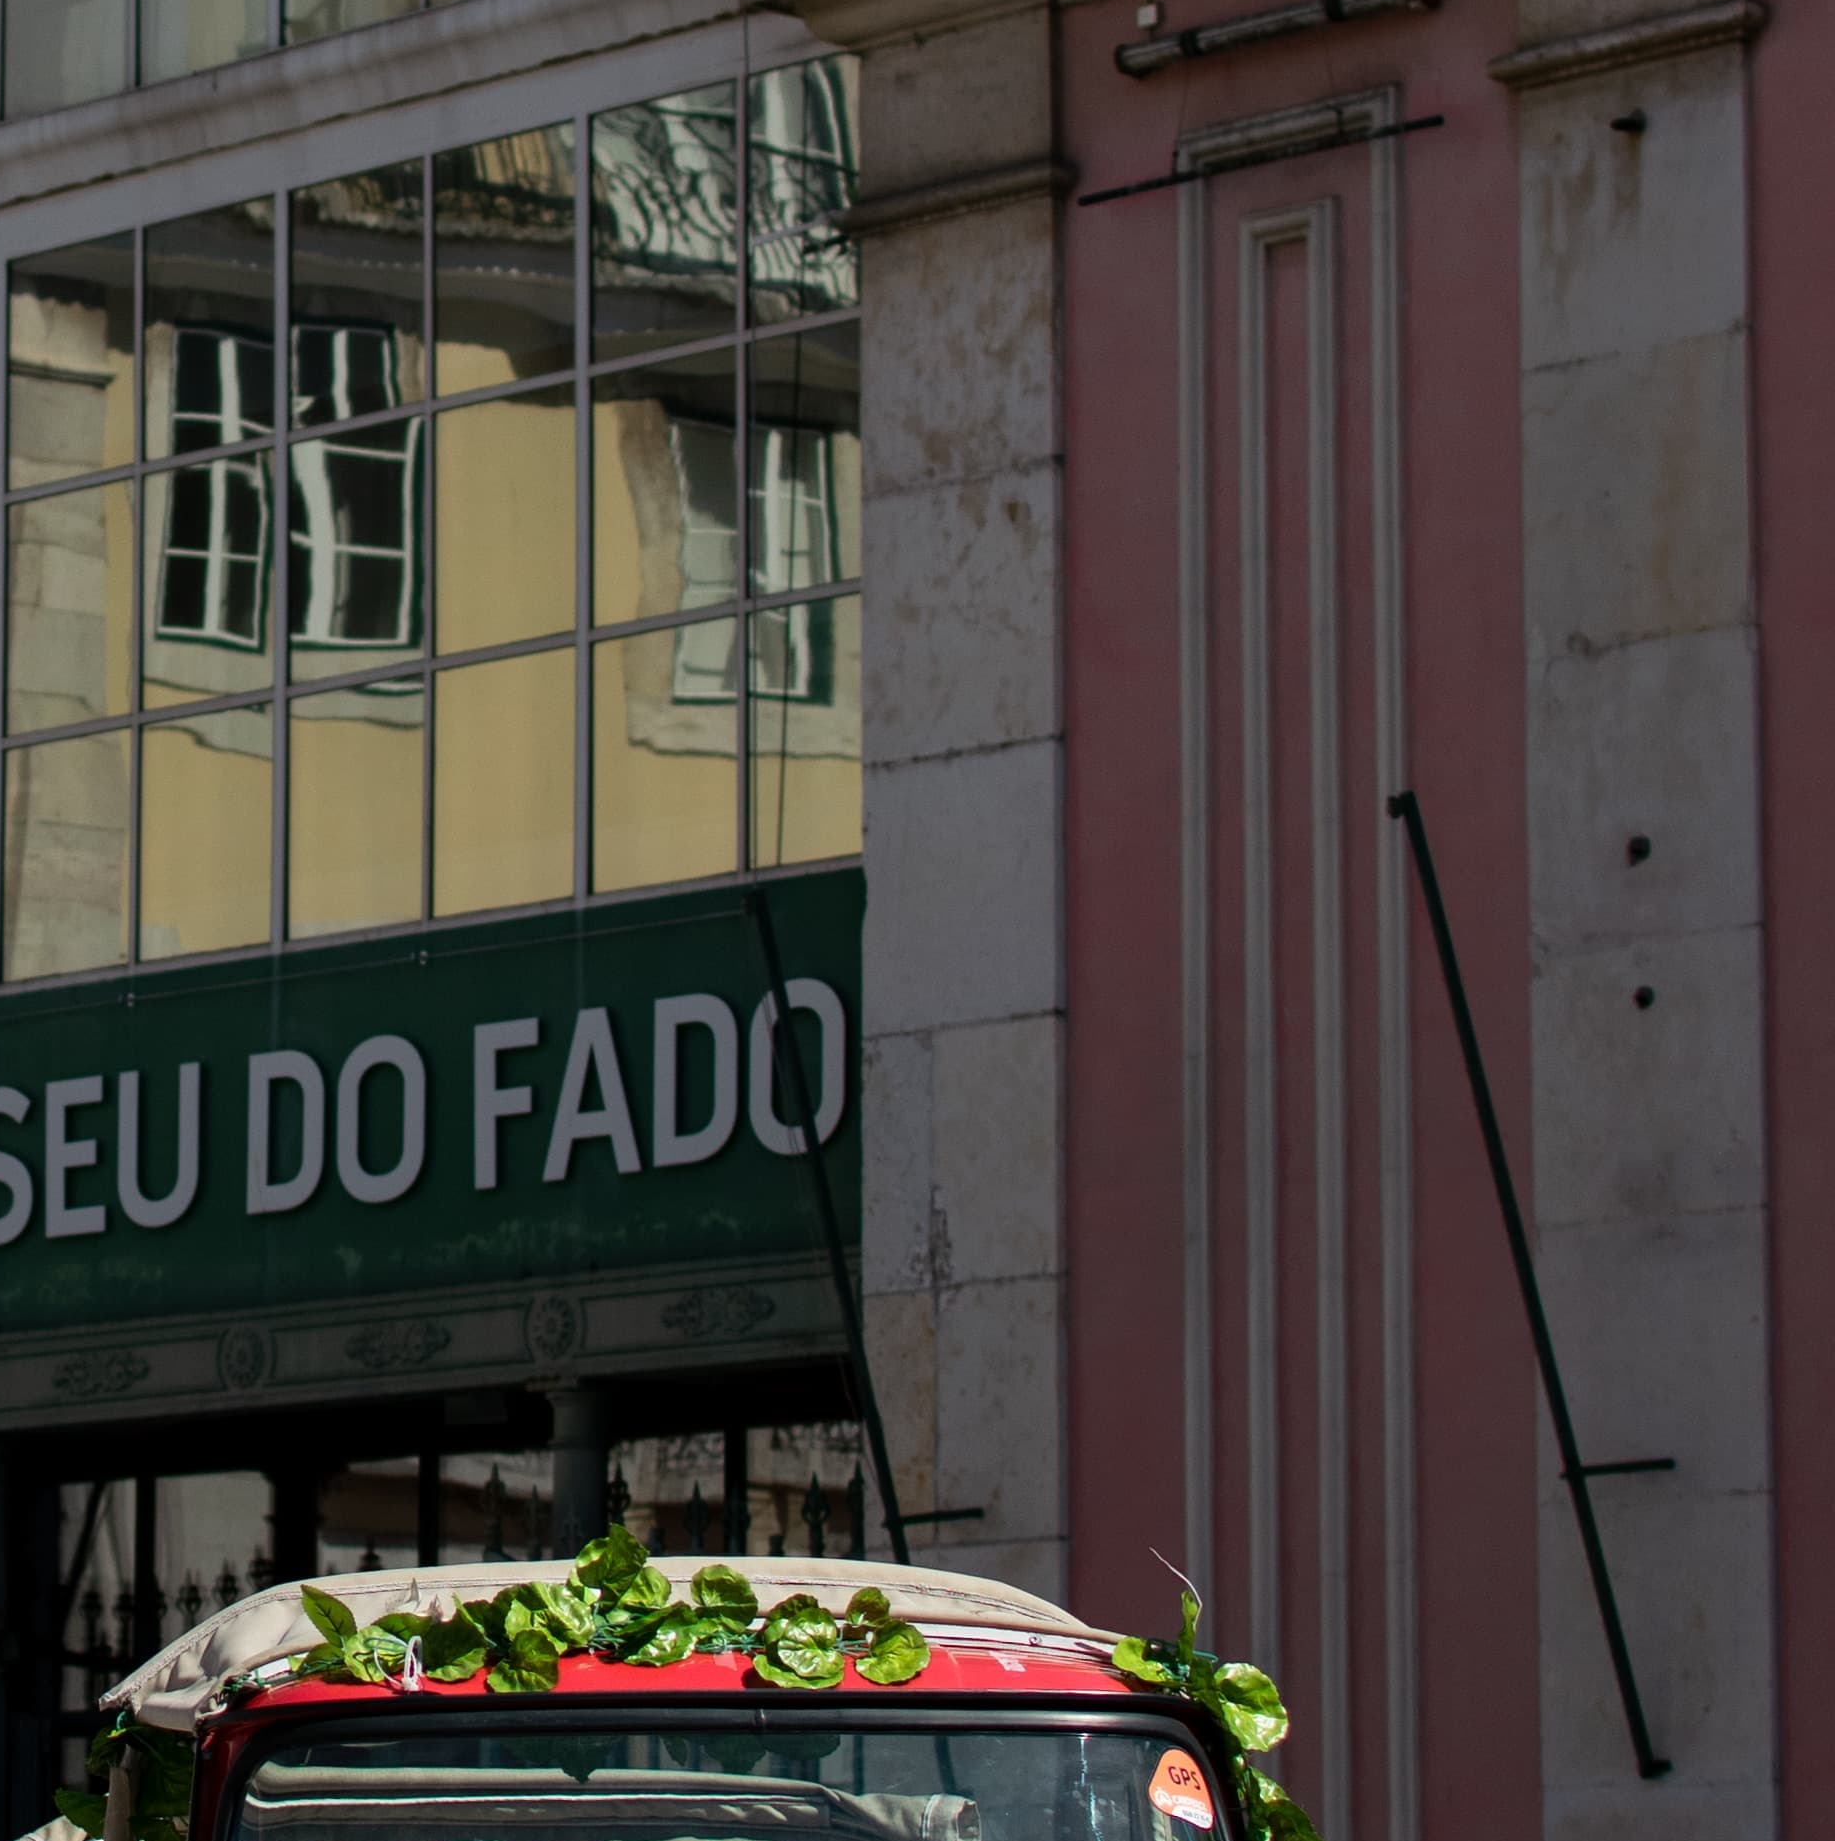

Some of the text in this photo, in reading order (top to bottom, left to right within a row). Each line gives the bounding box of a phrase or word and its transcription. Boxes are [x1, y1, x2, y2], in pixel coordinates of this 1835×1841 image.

[246, 1035, 427, 1215] DO
[473, 978, 846, 1190] FADO
[1167, 1765, 1201, 1790] GPS
